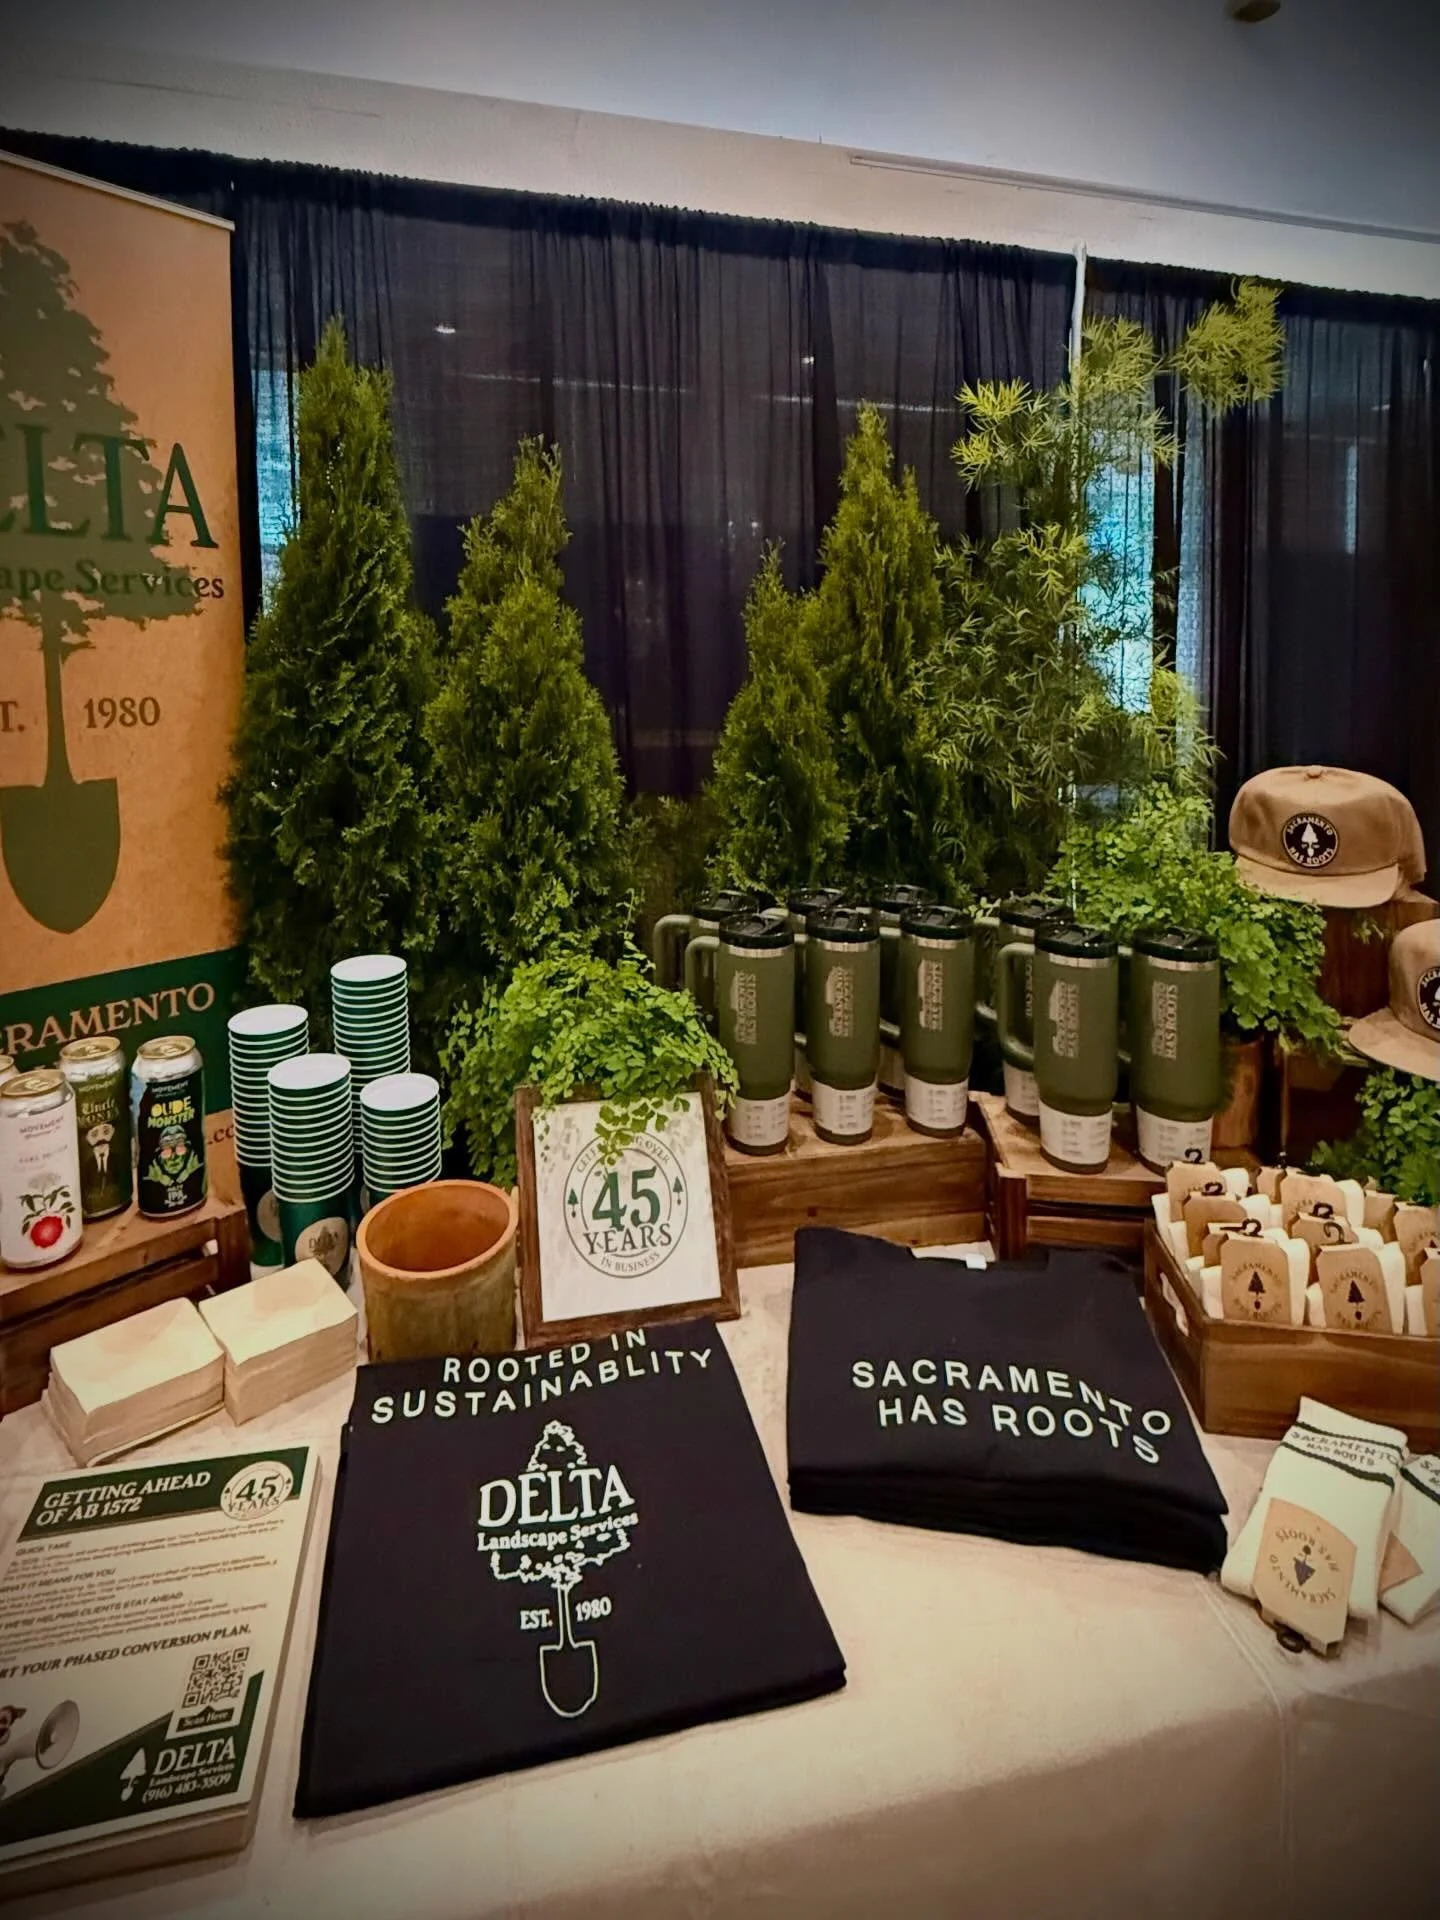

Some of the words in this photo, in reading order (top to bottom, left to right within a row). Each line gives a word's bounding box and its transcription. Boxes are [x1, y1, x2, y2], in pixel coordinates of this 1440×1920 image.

[0, 423, 219, 549] LTA
[75, 558, 225, 599] Services
[82, 697, 160, 729] 1980
[1286, 816, 1333, 836] SACRAMENTO
[1289, 846, 1305, 864] HAS
[1306, 848, 1335, 865] ROOTS
[0, 982, 216, 1056] RAMENTO
[1166, 984, 1177, 1030] ROOTS
[147, 1107, 195, 1128] MONSTER
[644, 1139, 671, 1165] OVER
[592, 1166, 661, 1232] 45
[583, 1222, 672, 1255] YEARS
[600, 1255, 612, 1270] IN
[615, 1252, 661, 1272] BUSINESS
[443, 1342, 591, 1383] ROOTED
[611, 1328, 647, 1351] IN
[371, 1348, 712, 1424] SUSTAINABLITY
[852, 1359, 1171, 1436] SACRAMENTO
[878, 1394, 968, 1428] HAS
[992, 1404, 1160, 1464] ROOTS
[1290, 1431, 1399, 1465] SACRAMENTO
[1333, 1448, 1375, 1467] ROOTS
[44, 1481, 138, 1509] GETTING
[139, 1471, 211, 1496] AHEAD
[228, 1496, 280, 1512] YEARS
[235, 1473, 281, 1502] 45
[477, 1464, 635, 1528] DELTA
[36, 1507, 68, 1527] OF
[68, 1502, 99, 1522] AB
[100, 1497, 143, 1517] 1572
[477, 1530, 567, 1552] Landscape
[569, 1511, 639, 1543] Services
[520, 1608, 553, 1630] EST.
[575, 1596, 612, 1622] 1980
[21, 1658, 62, 1677] YOUR
[63, 1647, 120, 1668] PHASED
[121, 1630, 211, 1656] CONVERSION
[212, 1623, 251, 1640] PLAN.
[206, 1711, 229, 1722] Here
[153, 1735, 236, 1776] DELTA
[142, 1784, 173, 1804] (916)
[174, 1772, 232, 1794] 483-3509
[149, 1770, 197, 1788] Landscape
[197, 1763, 235, 1777] Services
